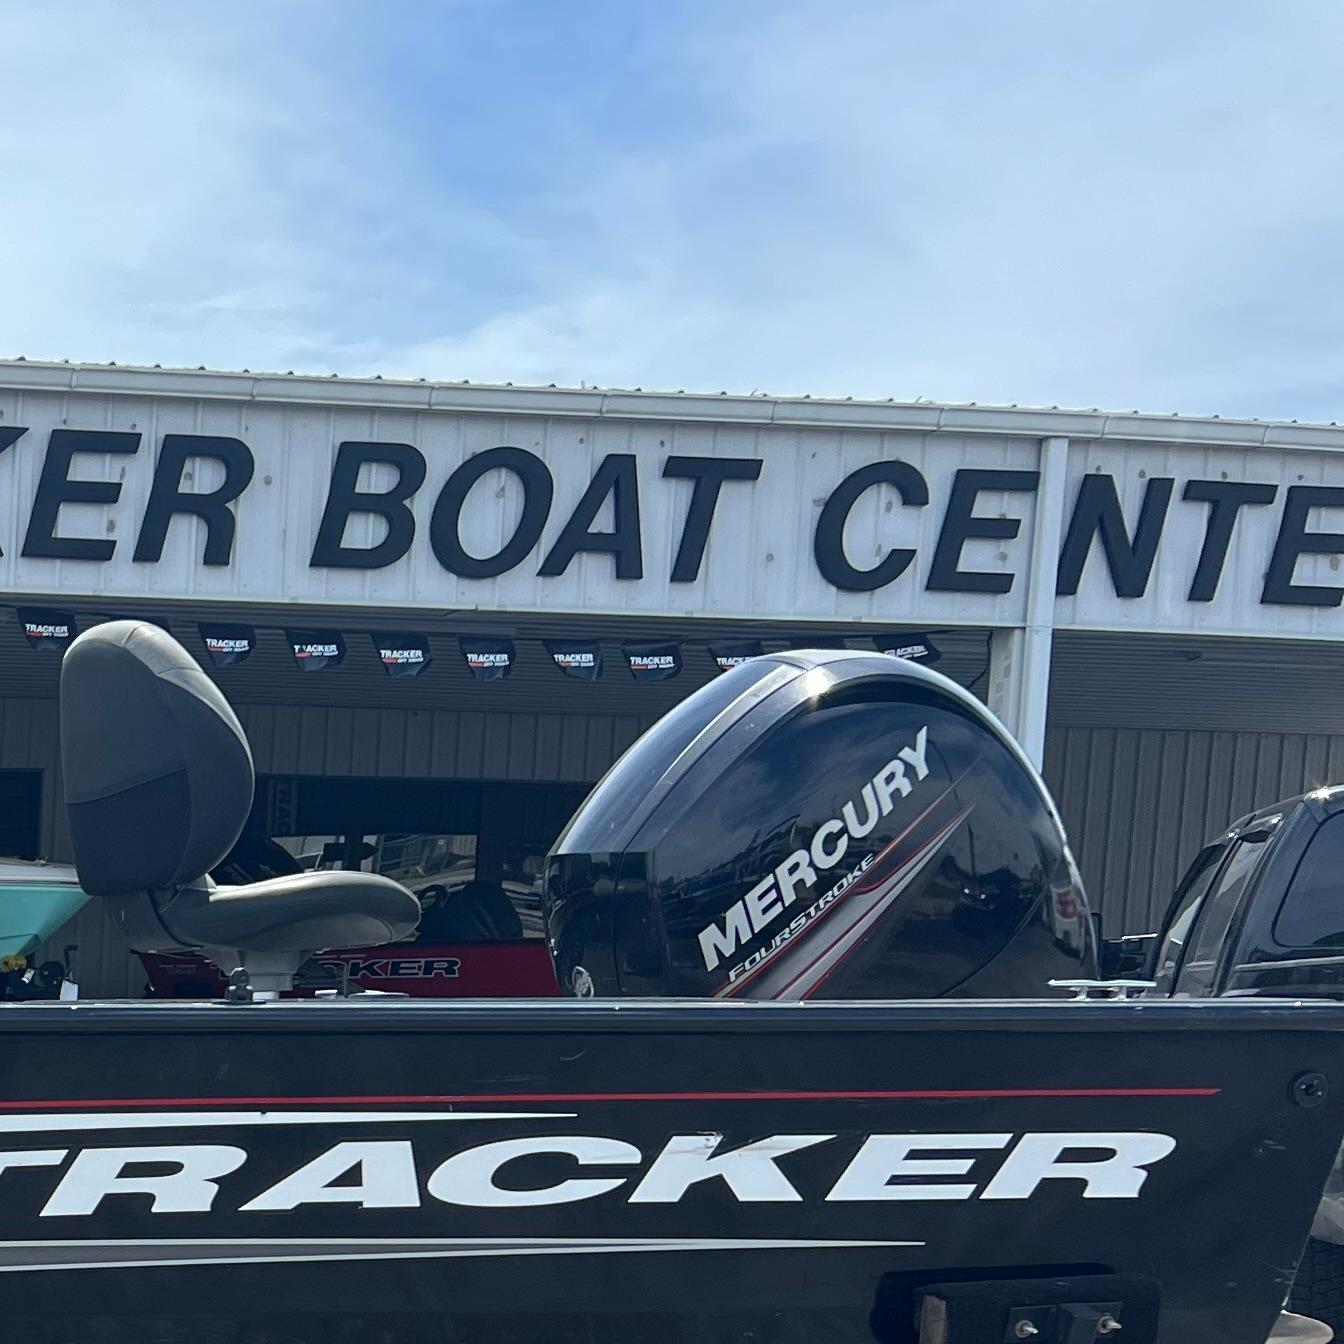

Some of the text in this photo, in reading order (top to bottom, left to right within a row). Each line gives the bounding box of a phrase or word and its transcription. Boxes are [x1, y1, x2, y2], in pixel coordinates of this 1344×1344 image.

[309, 440, 762, 584] BOAT
[25, 623, 68, 634] TRACKER
[205, 638, 249, 647] TRACKER
[380, 649, 423, 658] TRACKER
[467, 653, 508, 662] TRACKER
[553, 653, 594, 663] TRACKER
[630, 656, 673, 665] TRACKER
[698, 726, 929, 972] MERCURY
[728, 853, 875, 982] FOURSTROKE
